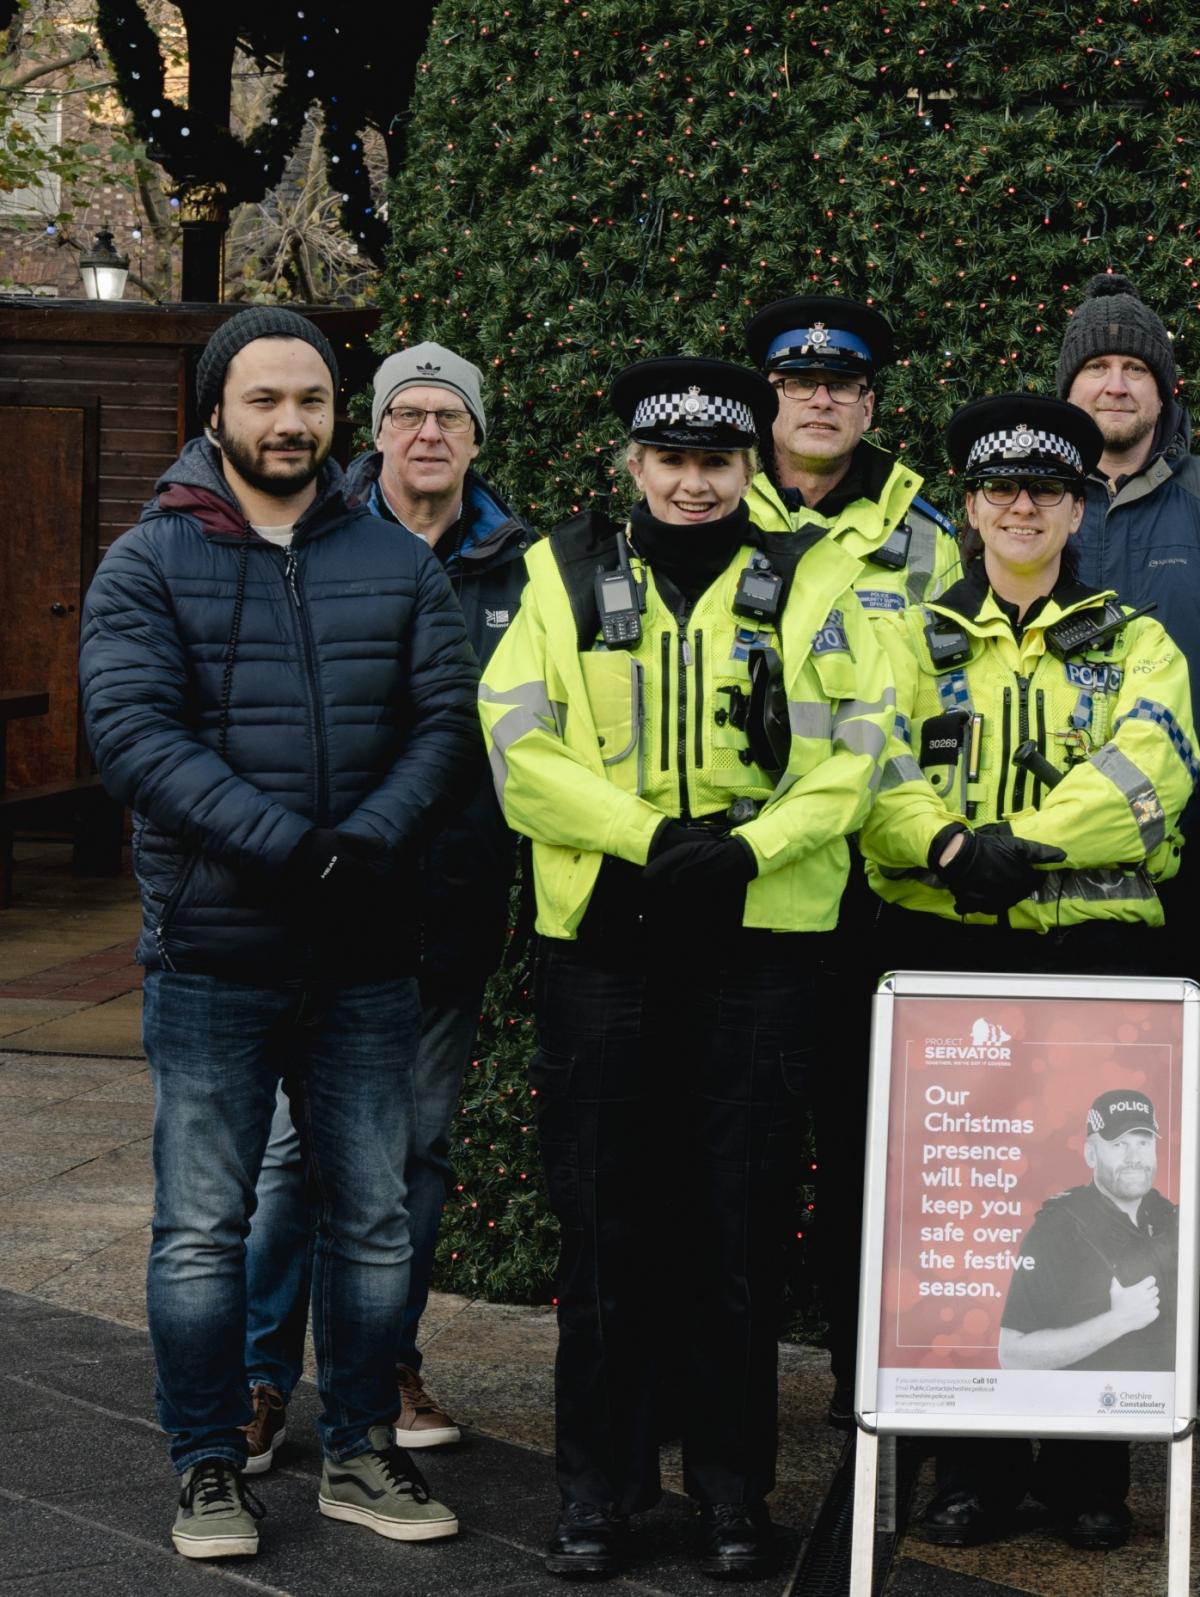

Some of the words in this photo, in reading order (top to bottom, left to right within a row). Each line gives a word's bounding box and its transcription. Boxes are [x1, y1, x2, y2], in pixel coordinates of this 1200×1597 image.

[1068, 664, 1122, 690] POLIC
[929, 738, 958, 750] 30269
[925, 1038, 963, 1046] PROJECT
[924, 1046, 1011, 1060] SERVATOR
[925, 1085, 970, 1105] Our
[1109, 1101, 1150, 1115] POLICE
[924, 1112, 1034, 1134] Christmas
[923, 1144, 1021, 1164] presence
[921, 1166, 962, 1187] will
[970, 1167, 1018, 1193] help
[921, 1194, 973, 1220] keep
[980, 1200, 1022, 1219] you
[920, 1222, 965, 1242] safe
[973, 1228, 1022, 1243] over
[919, 1249, 955, 1269] the
[963, 1249, 1035, 1270] festive
[918, 1281, 1002, 1298] season.
[972, 1377, 985, 1385] Call
[1119, 1392, 1152, 1400] Cheshire
[1119, 1401, 1166, 1409] Constabulary
